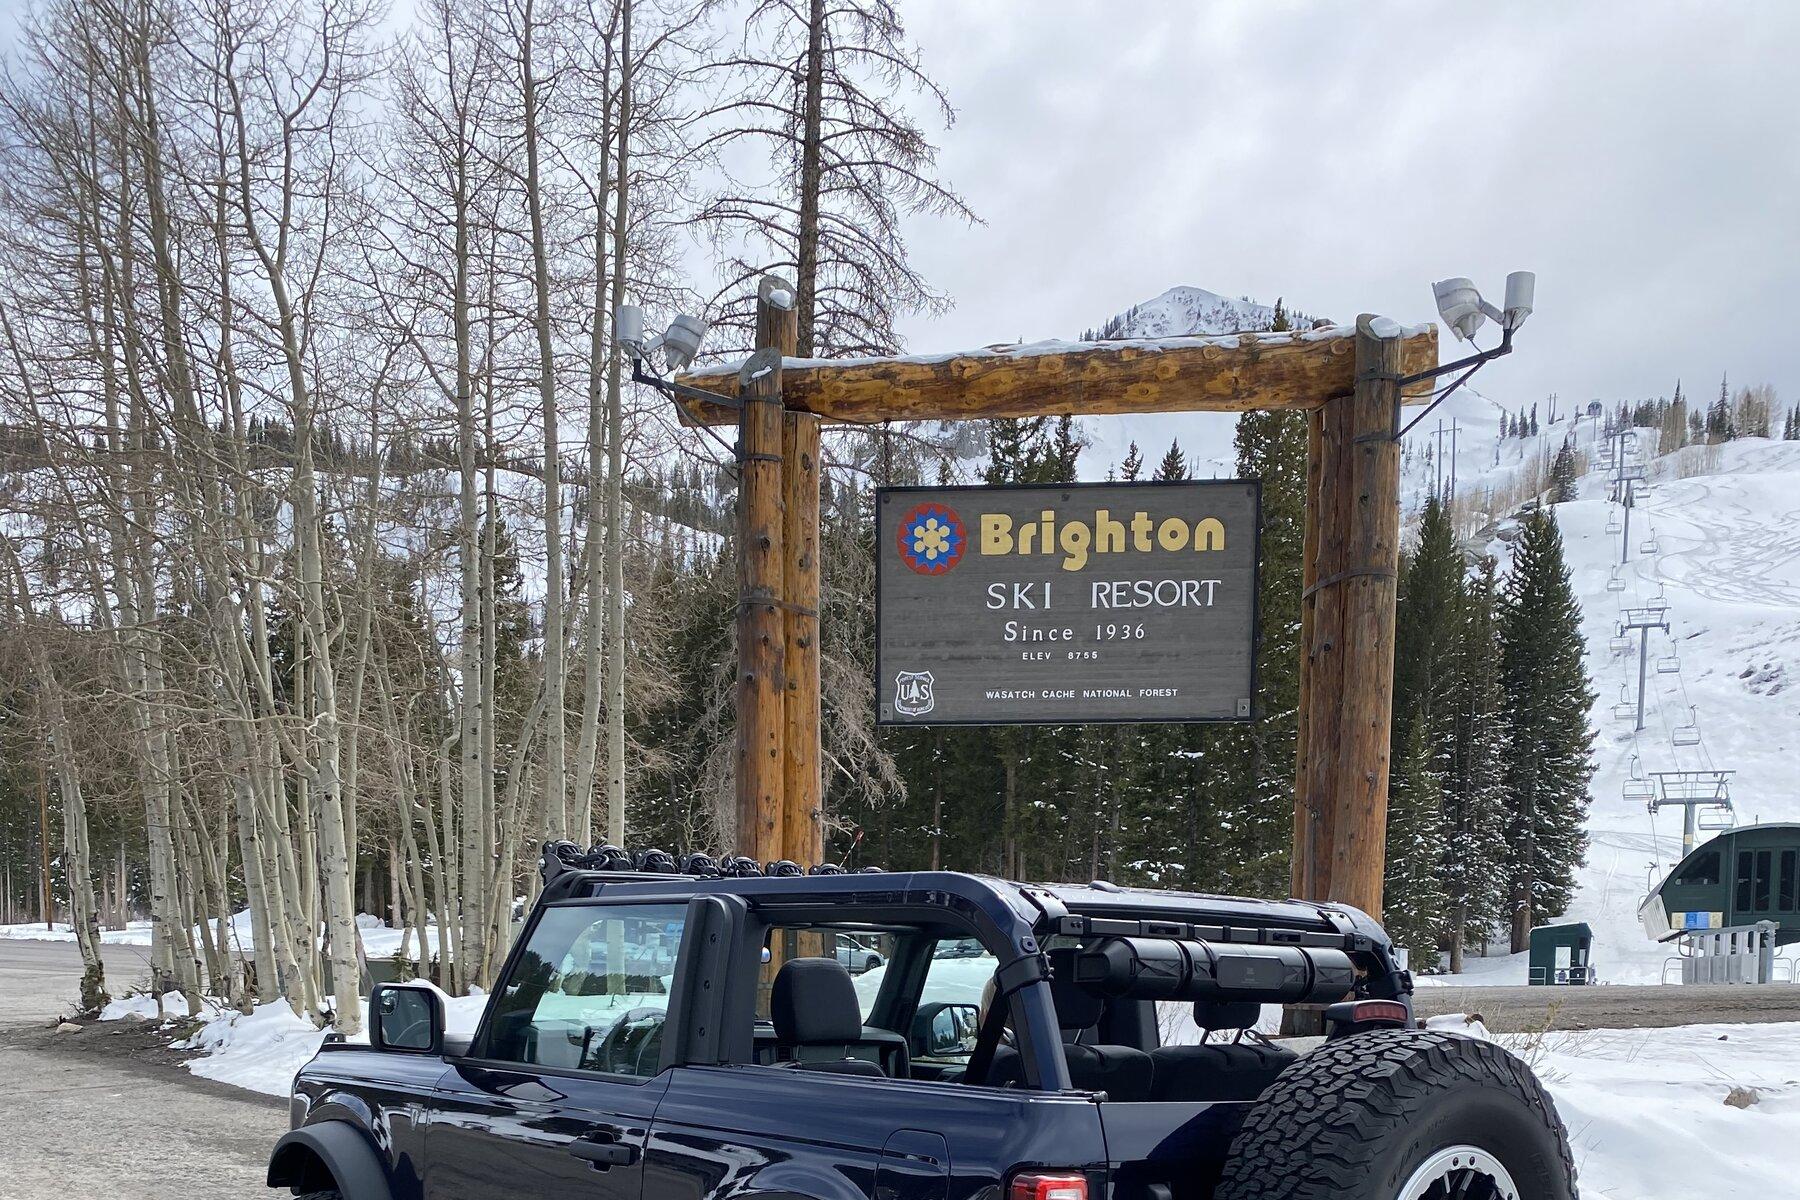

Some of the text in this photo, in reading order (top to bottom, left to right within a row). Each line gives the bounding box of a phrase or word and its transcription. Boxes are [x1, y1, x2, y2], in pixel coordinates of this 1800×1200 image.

[979, 509, 1226, 572] Brighton
[986, 579, 1222, 610] SKI RESORT
[1004, 620, 1146, 642] Since 1936
[1022, 652, 1052, 660] ELEV
[985, 688, 1179, 699] WASATCH CACHE NATIONAL FOREST
